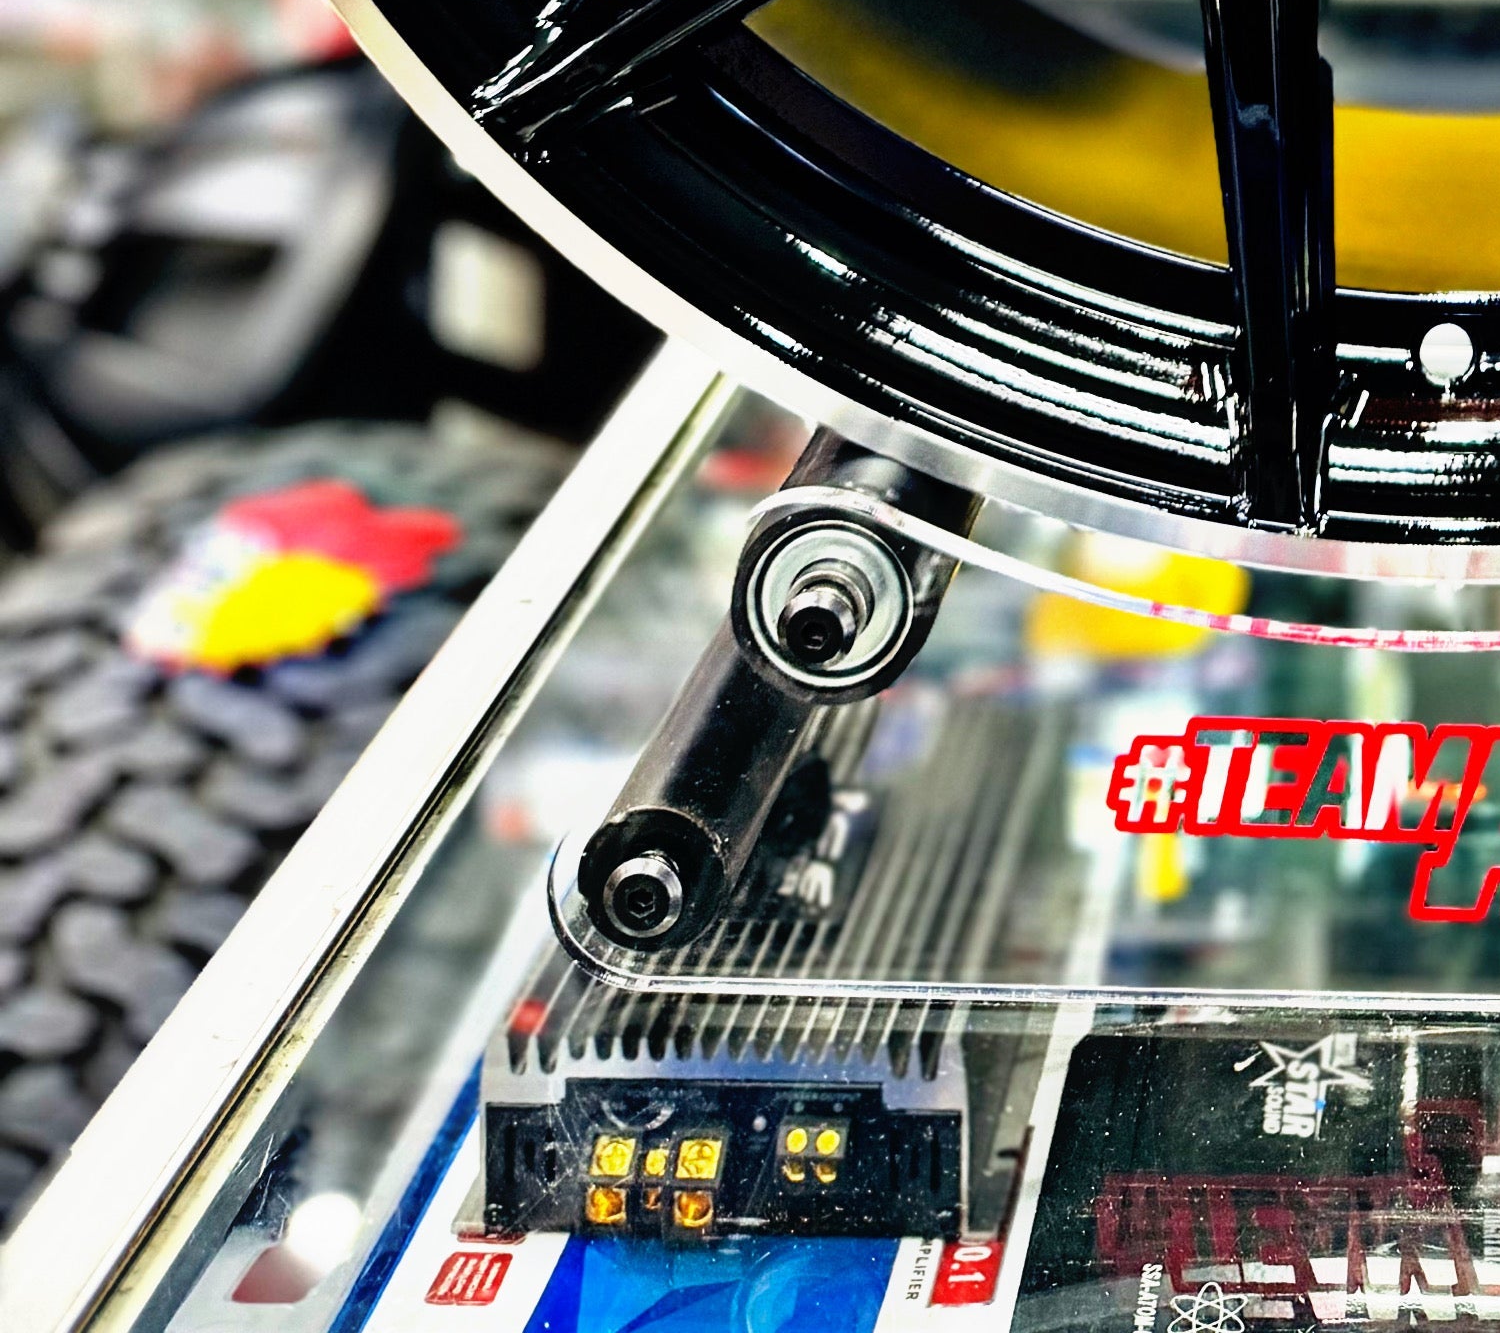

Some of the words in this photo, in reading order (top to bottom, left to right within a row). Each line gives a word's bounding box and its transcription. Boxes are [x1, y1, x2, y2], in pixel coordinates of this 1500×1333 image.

[1263, 1086, 1285, 1134] SOUND
[1280, 1060, 1319, 1137] STAR
[948, 1238, 992, 1283] 0.1
[1132, 1263, 1163, 1333] SSA-ATOM-
